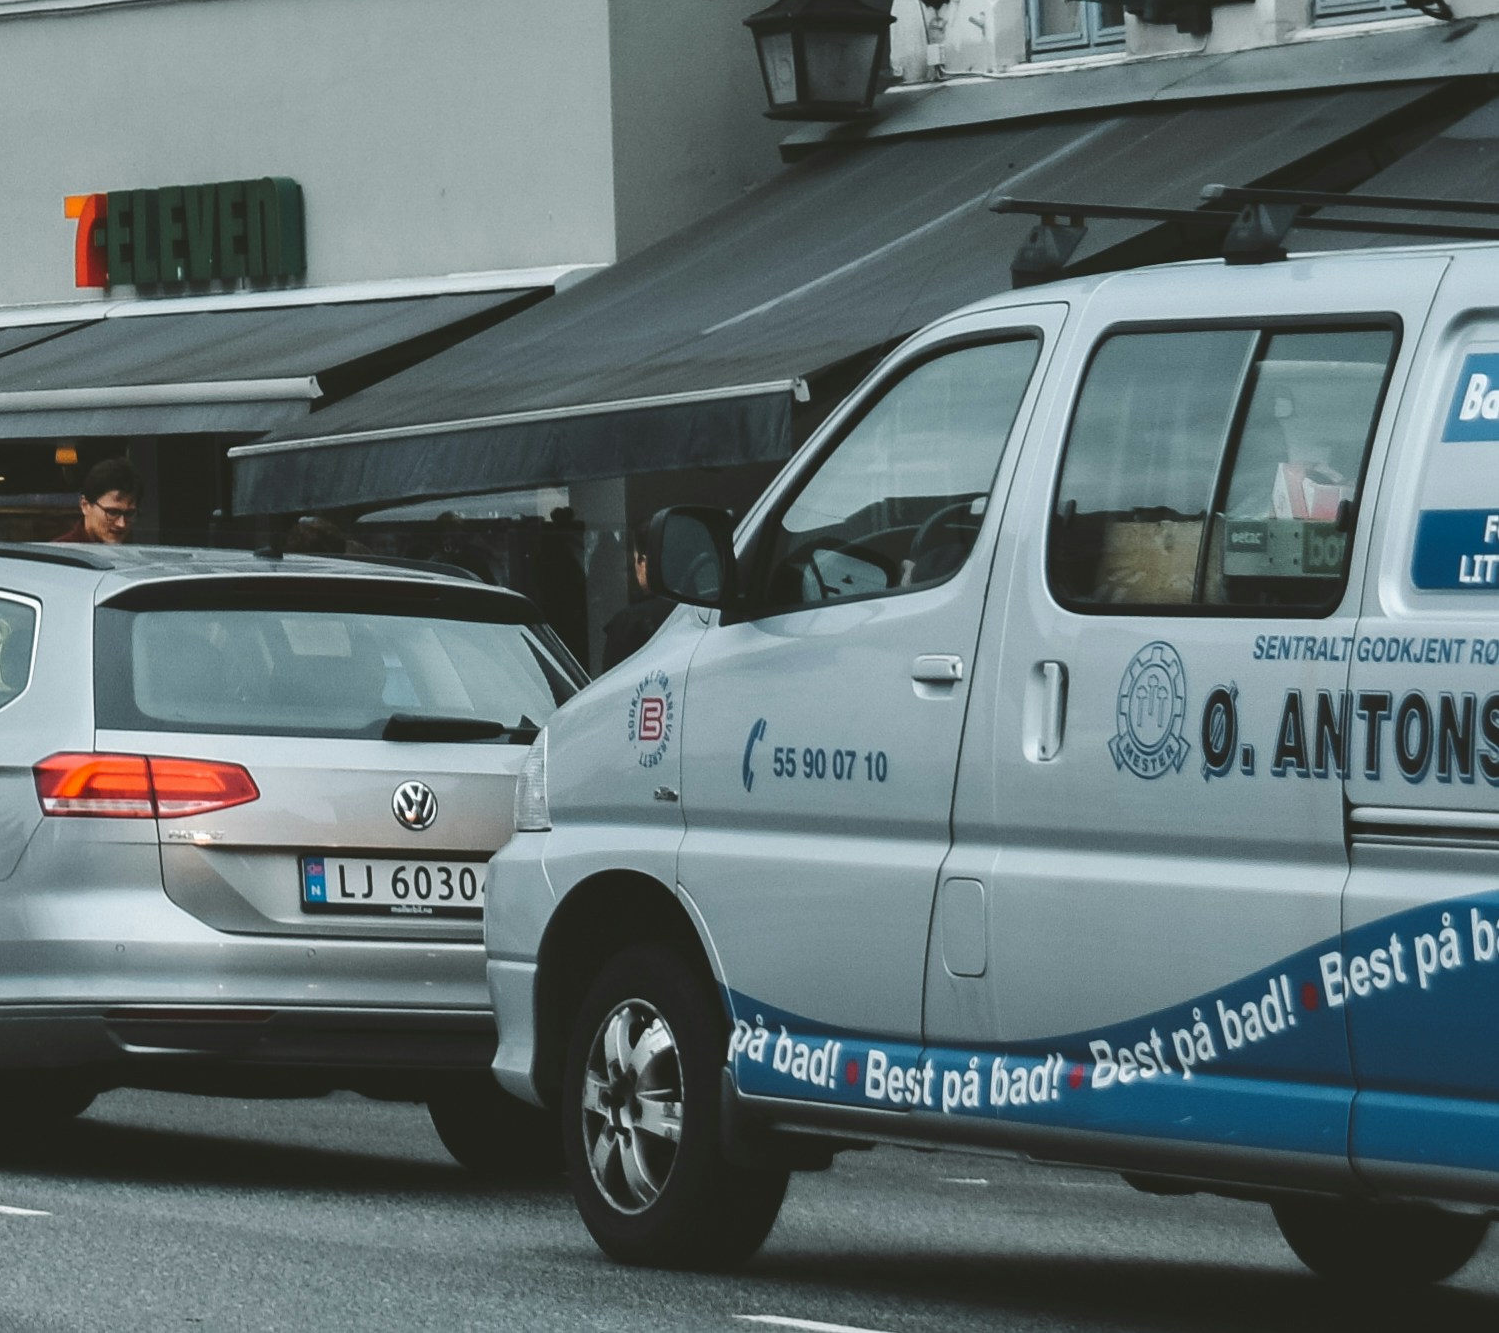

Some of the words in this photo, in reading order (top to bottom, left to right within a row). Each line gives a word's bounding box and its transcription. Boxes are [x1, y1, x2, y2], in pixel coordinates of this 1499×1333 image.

[1252, 634, 1352, 663] SENTRALT
[1357, 636, 1466, 665] GODKJENT
[773, 746, 797, 778] 55
[803, 747, 826, 779] 90
[833, 748, 857, 781] 07
[864, 750, 888, 783] 10
[1121, 738, 1177, 774] MESTER
[338, 864, 374, 899] LJ
[390, 865, 485, 901] 6030
[727, 1014, 772, 1063] på
[772, 1025, 843, 1090] bad!
[864, 1048, 934, 1107] Best
[941, 1055, 981, 1115] på
[989, 1050, 1064, 1107] bad!
[1088, 1027, 1173, 1090] Best
[1171, 1006, 1217, 1082] på
[1216, 973, 1299, 1051] bad!
[1318, 932, 1408, 1008] Best
[1413, 911, 1462, 989] på
[1470, 907, 1499, 963] b
